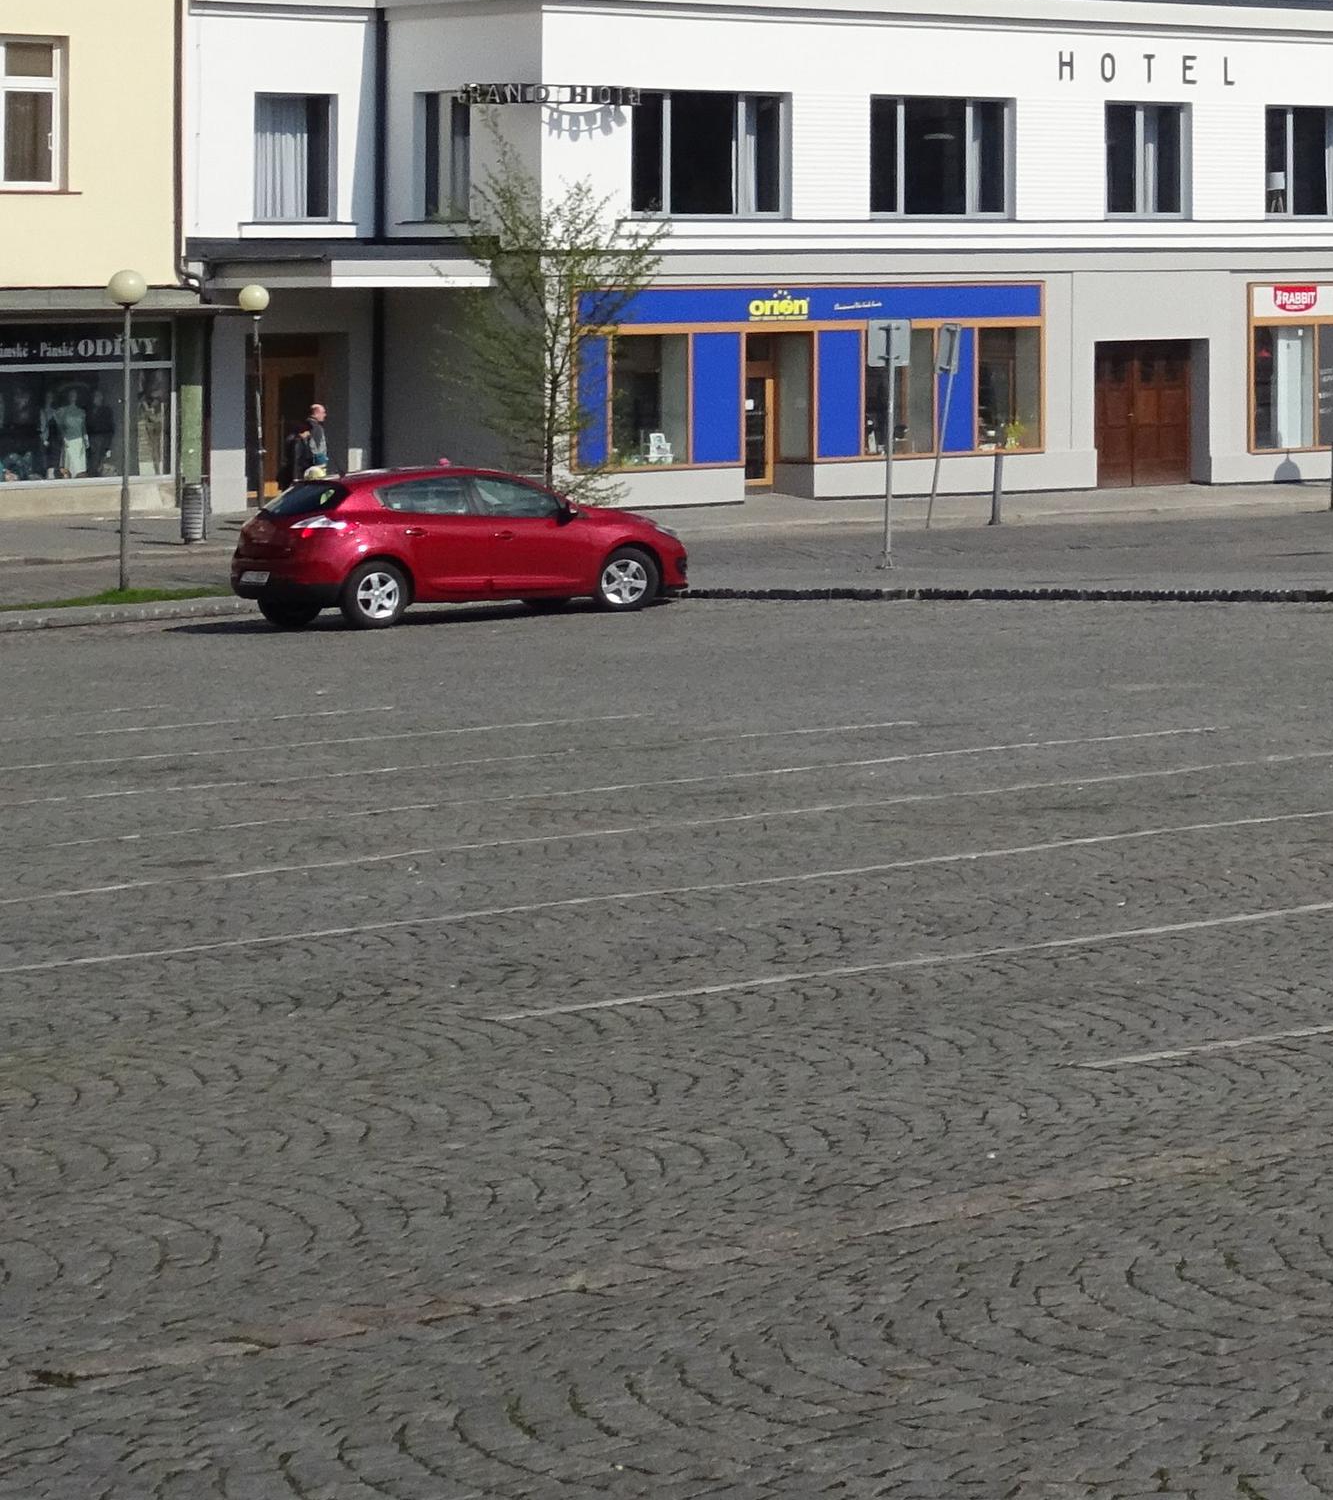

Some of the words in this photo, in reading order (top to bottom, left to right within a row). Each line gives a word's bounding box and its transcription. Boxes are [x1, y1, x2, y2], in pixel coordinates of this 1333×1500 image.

[1058, 51, 1235, 86] HOTEL
[457, 83, 550, 103] GRAND
[749, 298, 808, 315] orion
[1282, 290, 1315, 305] RABBIT
[0, 342, 29, 359] ámské
[40, 341, 74, 358] Pánské
